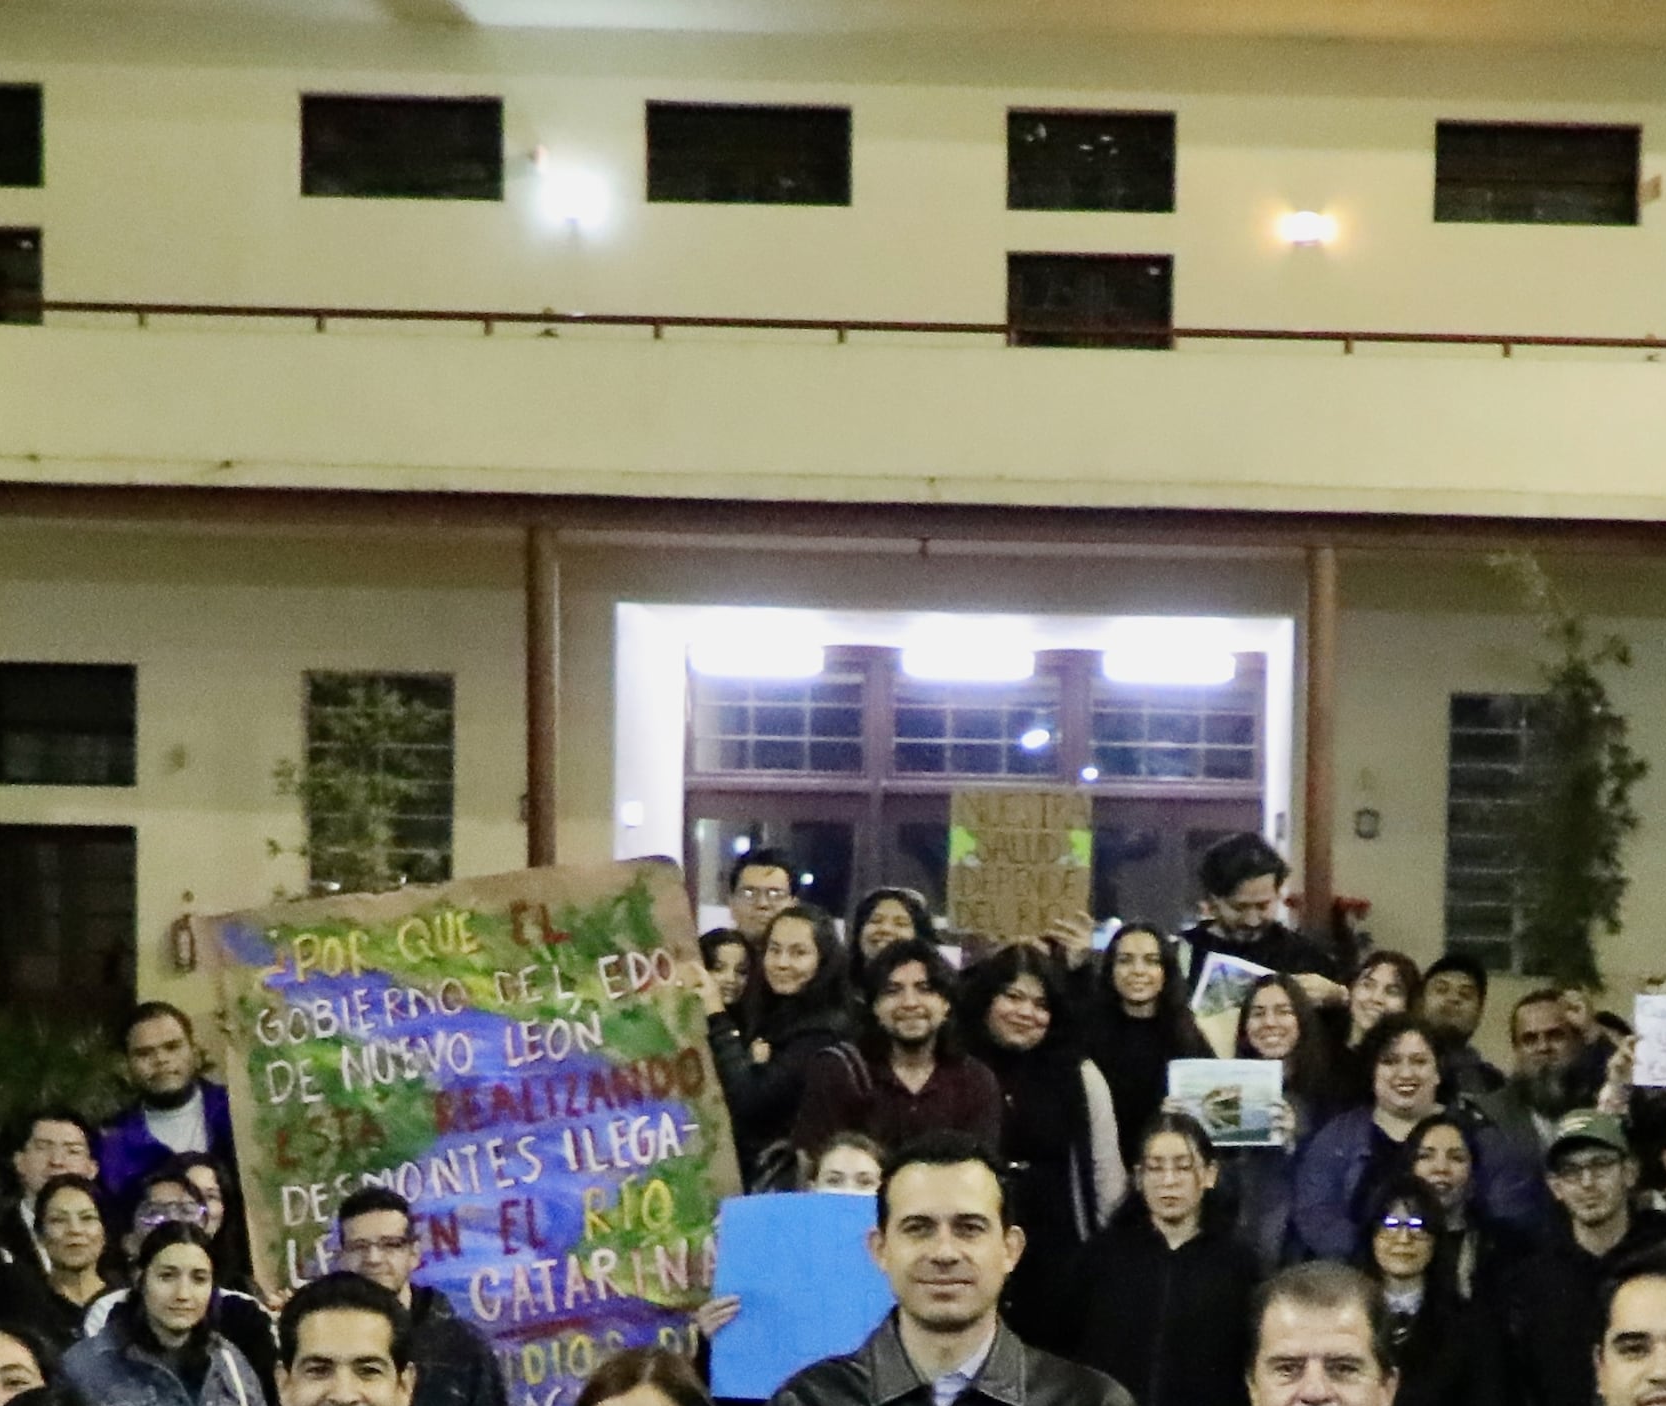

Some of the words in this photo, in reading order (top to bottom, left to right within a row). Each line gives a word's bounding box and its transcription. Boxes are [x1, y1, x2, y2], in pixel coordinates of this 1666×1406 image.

[510, 902, 570, 944] EL
[255, 976, 468, 1047] GOBIERNO
[494, 964, 576, 1005] DEL
[266, 1059, 325, 1104] DE
[341, 1030, 475, 1093] NUEVO
[433, 1046, 707, 1134] REALIZANDO
[499, 1197, 548, 1256] EL
